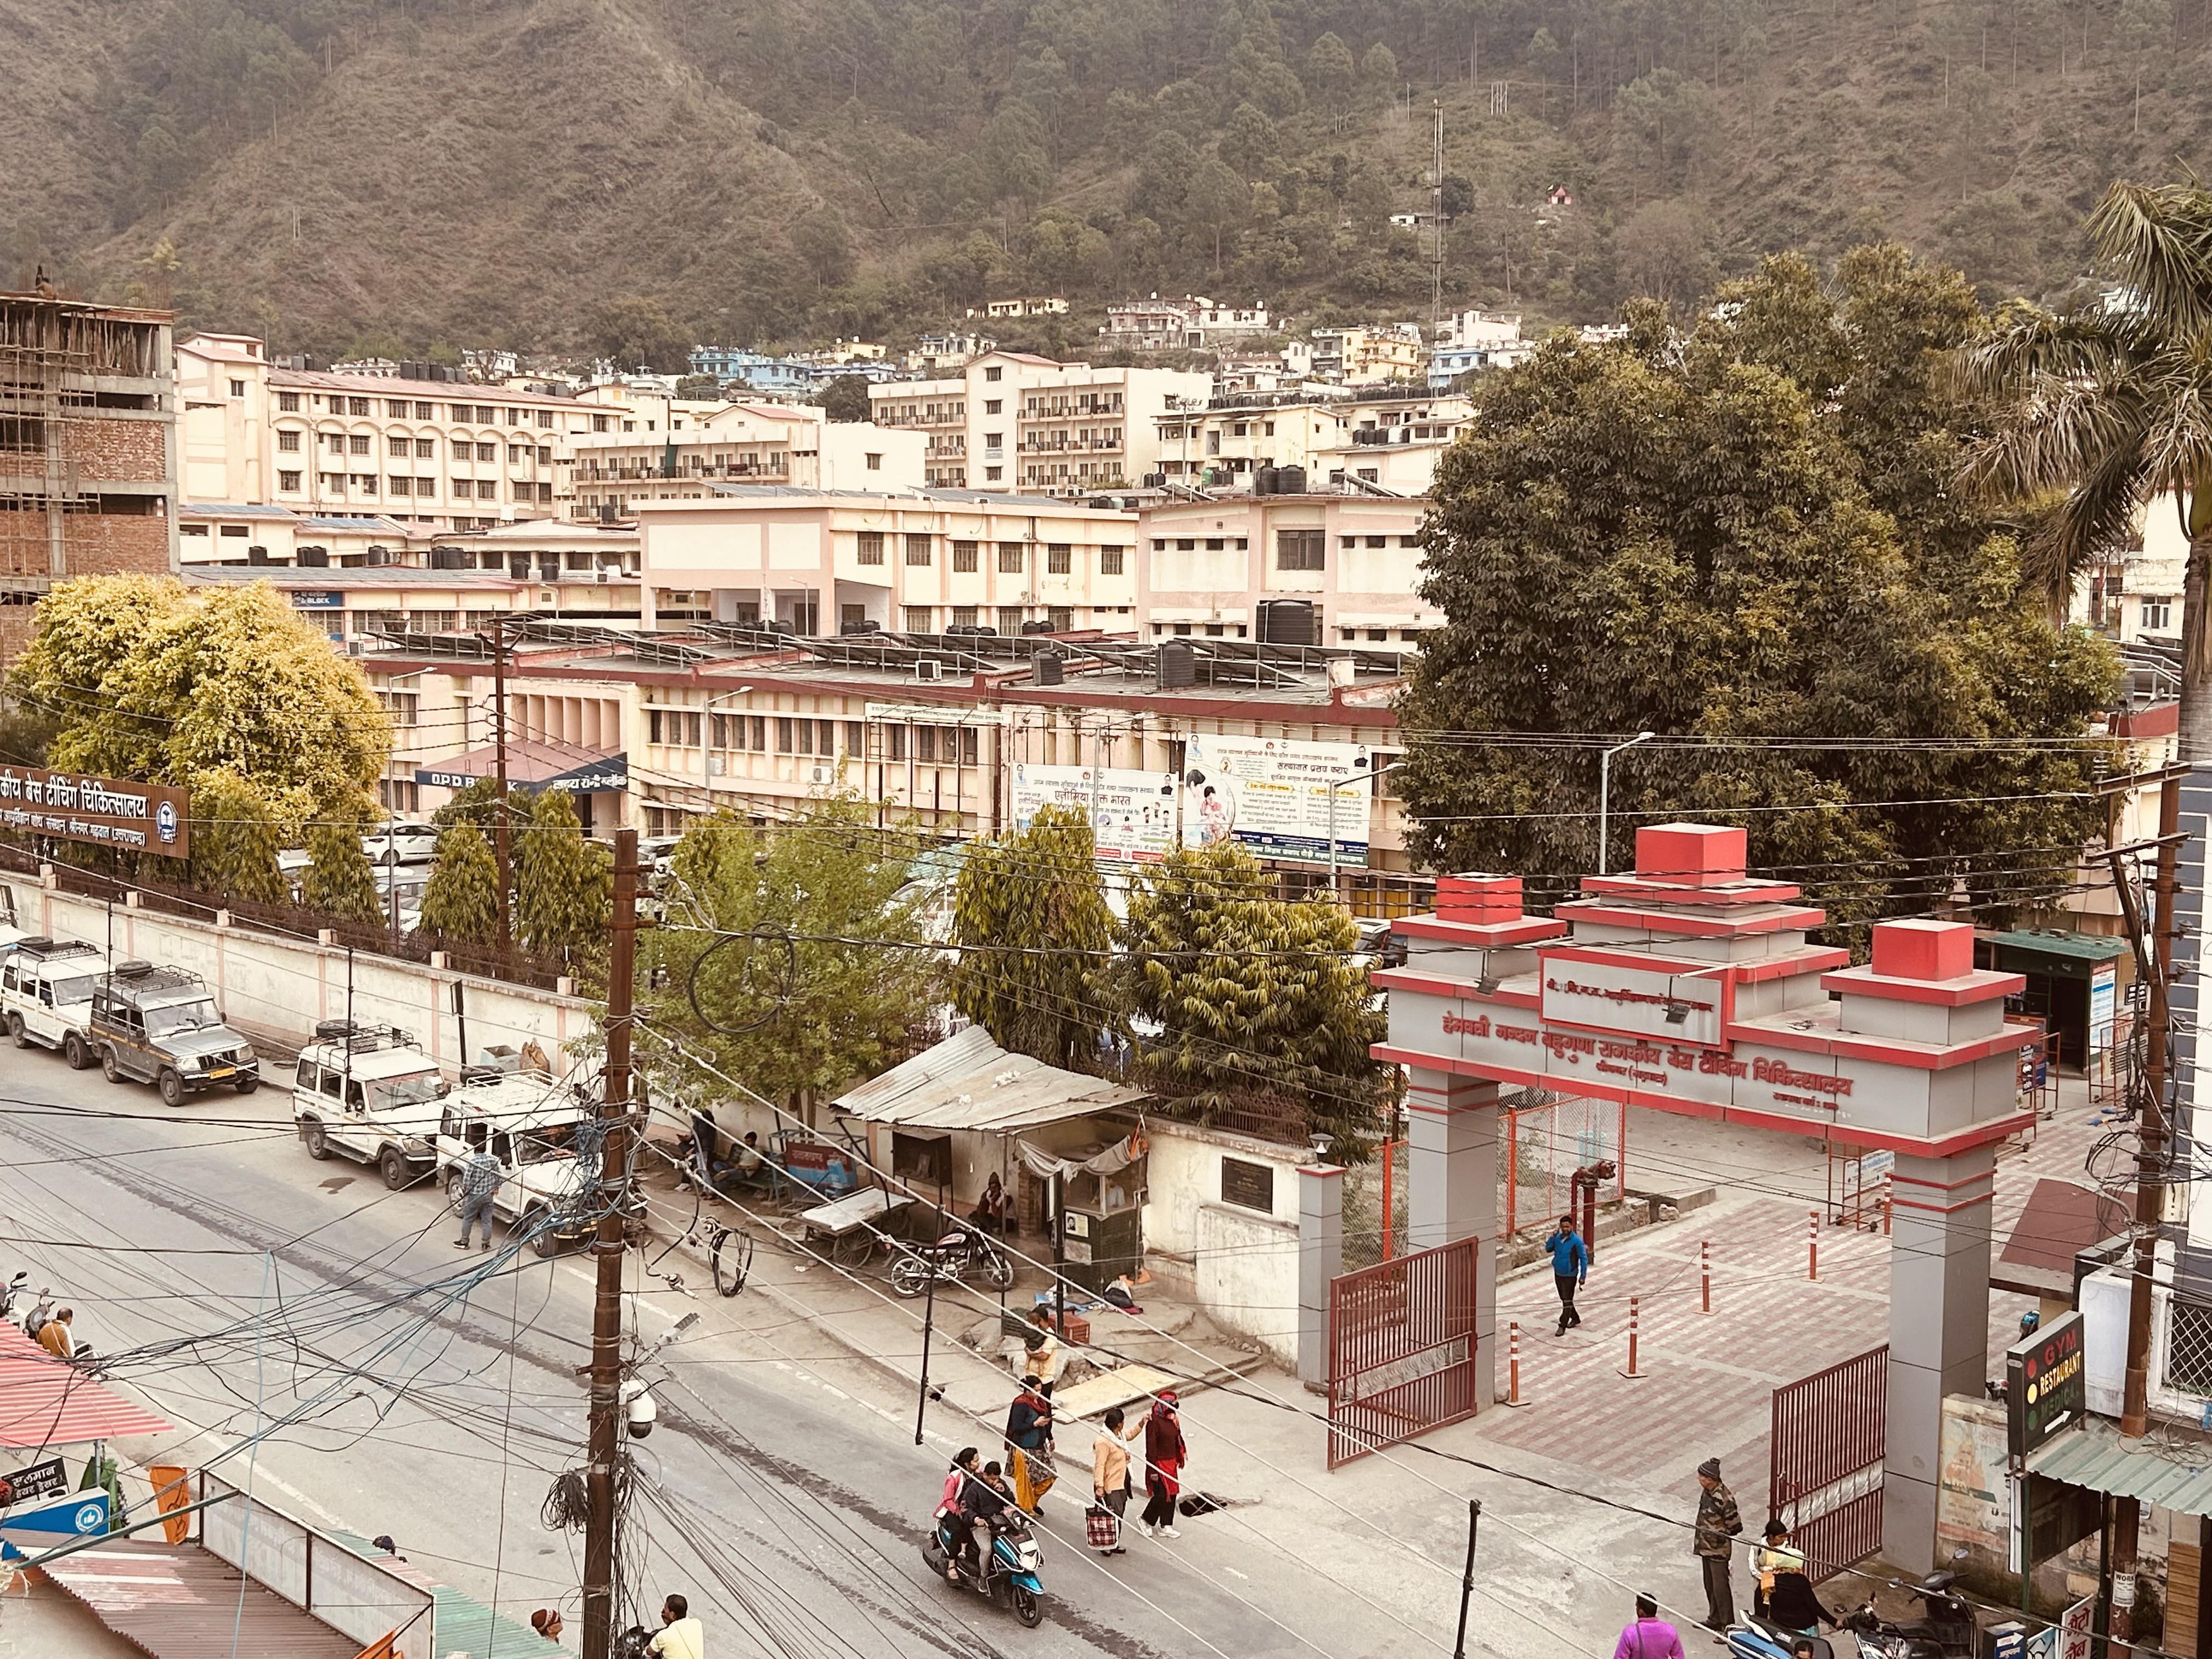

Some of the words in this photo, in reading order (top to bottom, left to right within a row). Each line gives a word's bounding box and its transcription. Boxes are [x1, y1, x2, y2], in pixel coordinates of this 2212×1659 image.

[25, 772, 43, 804] बेस
[46, 775, 78, 810] टीचिंग
[81, 779, 148, 818] चिकित्सालय
[1442, 1010, 1491, 1038] हेमवती
[1495, 1023, 1538, 1046] नन्दन
[1541, 1030, 1596, 1064] बहुगुणा
[1598, 1039, 1662, 1066] राजकीय
[1667, 1045, 1695, 1071] बेस
[1752, 1057, 1854, 1096] चिकित्सालय
[2044, 1328, 2076, 1365] GYM
[2040, 1350, 2081, 1397] RESTAURANT
[2040, 1383, 2080, 1420] MEDICAL
